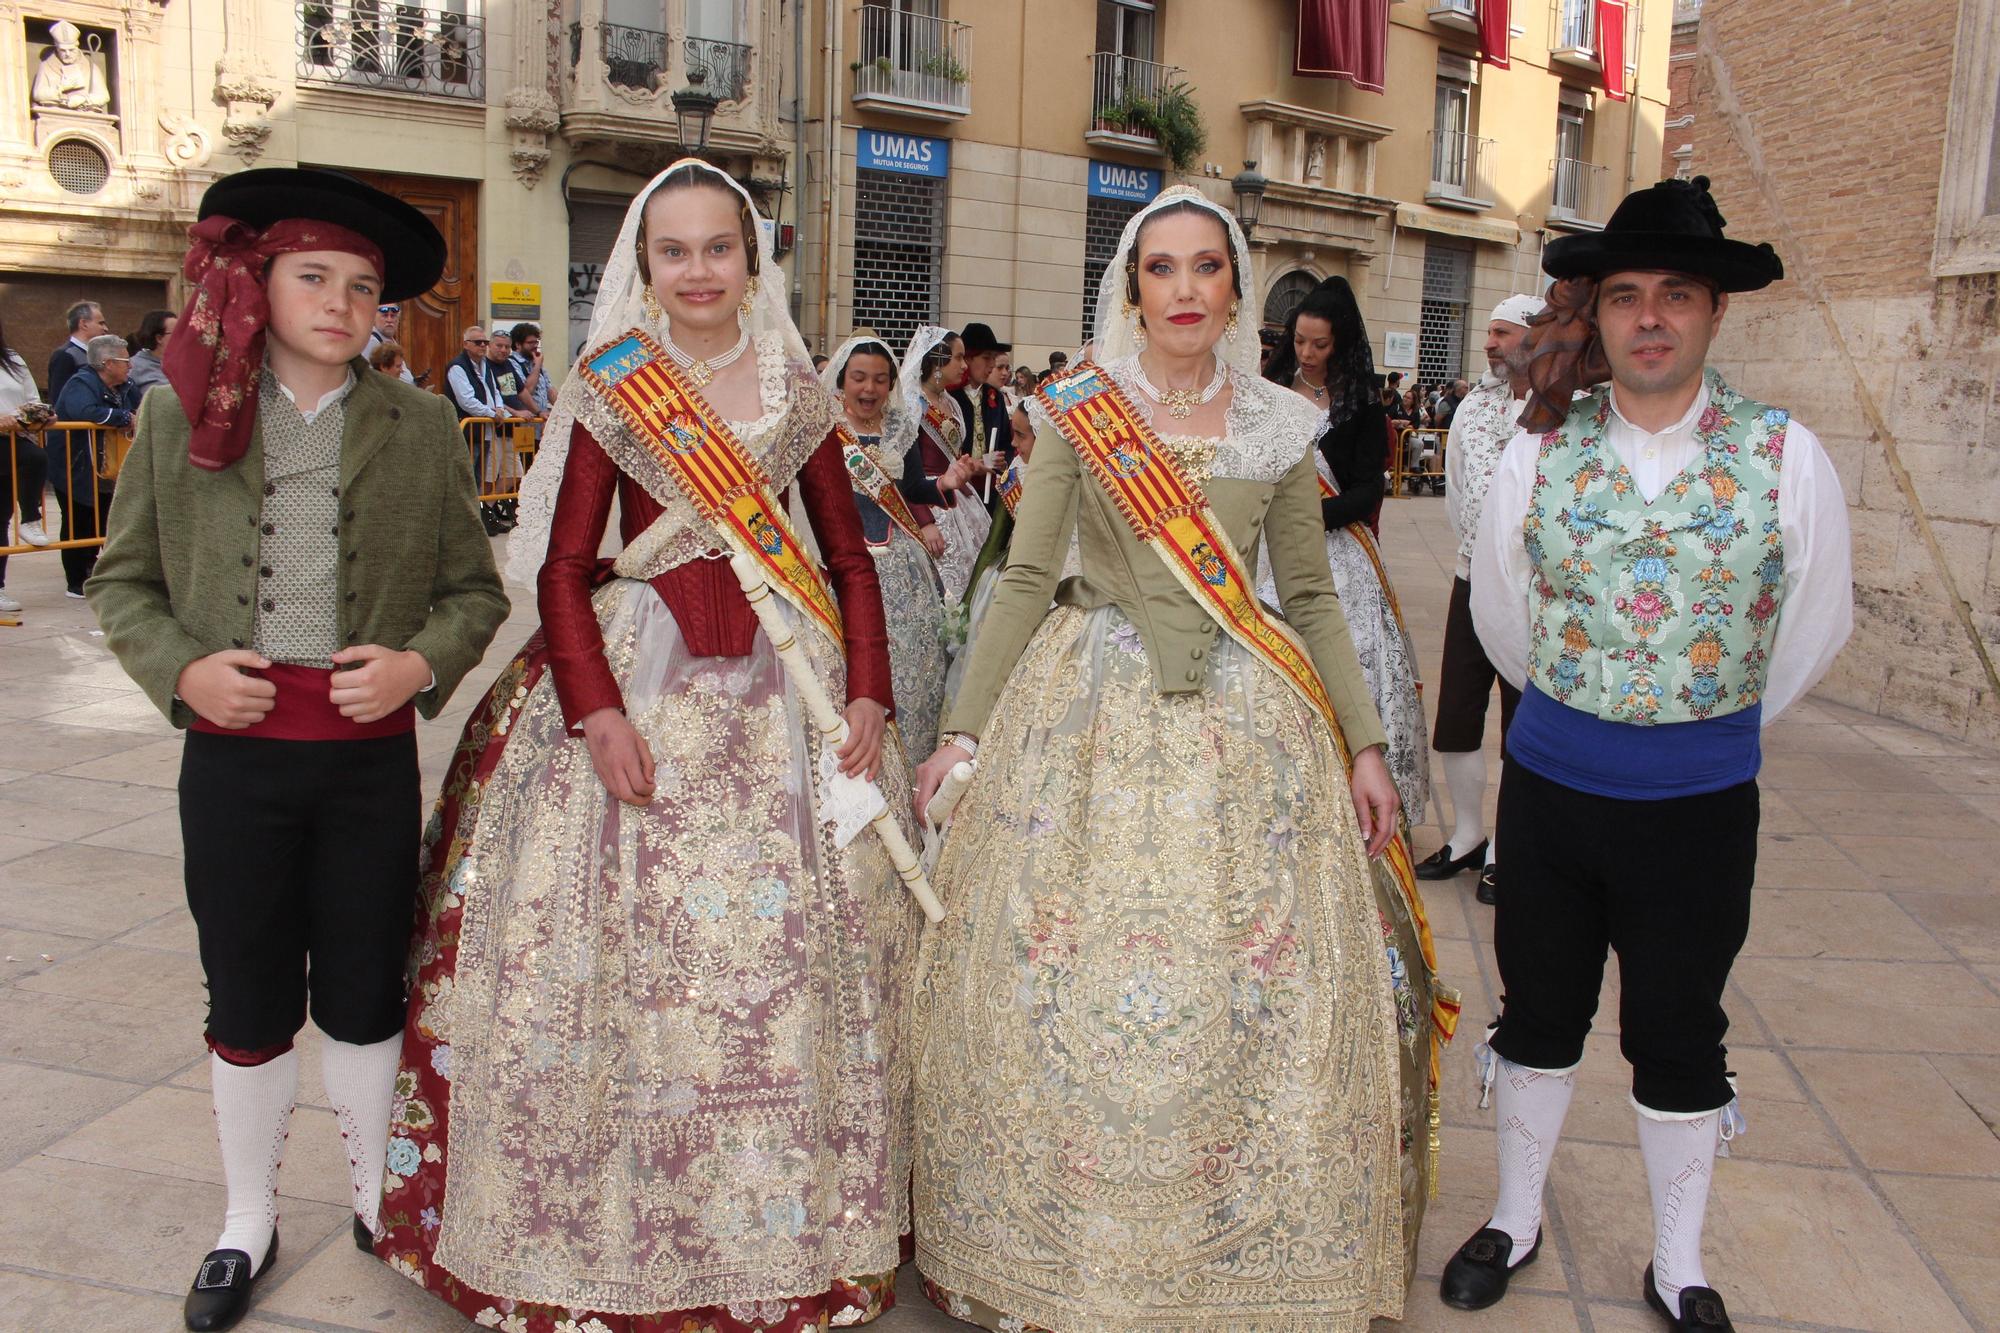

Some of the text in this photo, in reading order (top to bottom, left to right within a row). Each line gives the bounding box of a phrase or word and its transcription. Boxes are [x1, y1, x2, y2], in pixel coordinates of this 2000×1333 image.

[870, 134, 932, 162] UMAS
[873, 158, 929, 172] MUTUA DE SEGUROS
[1098, 165, 1149, 191] UMAS
[1100, 186, 1118, 195] MUTUA
[641, 389, 680, 420] 2022
